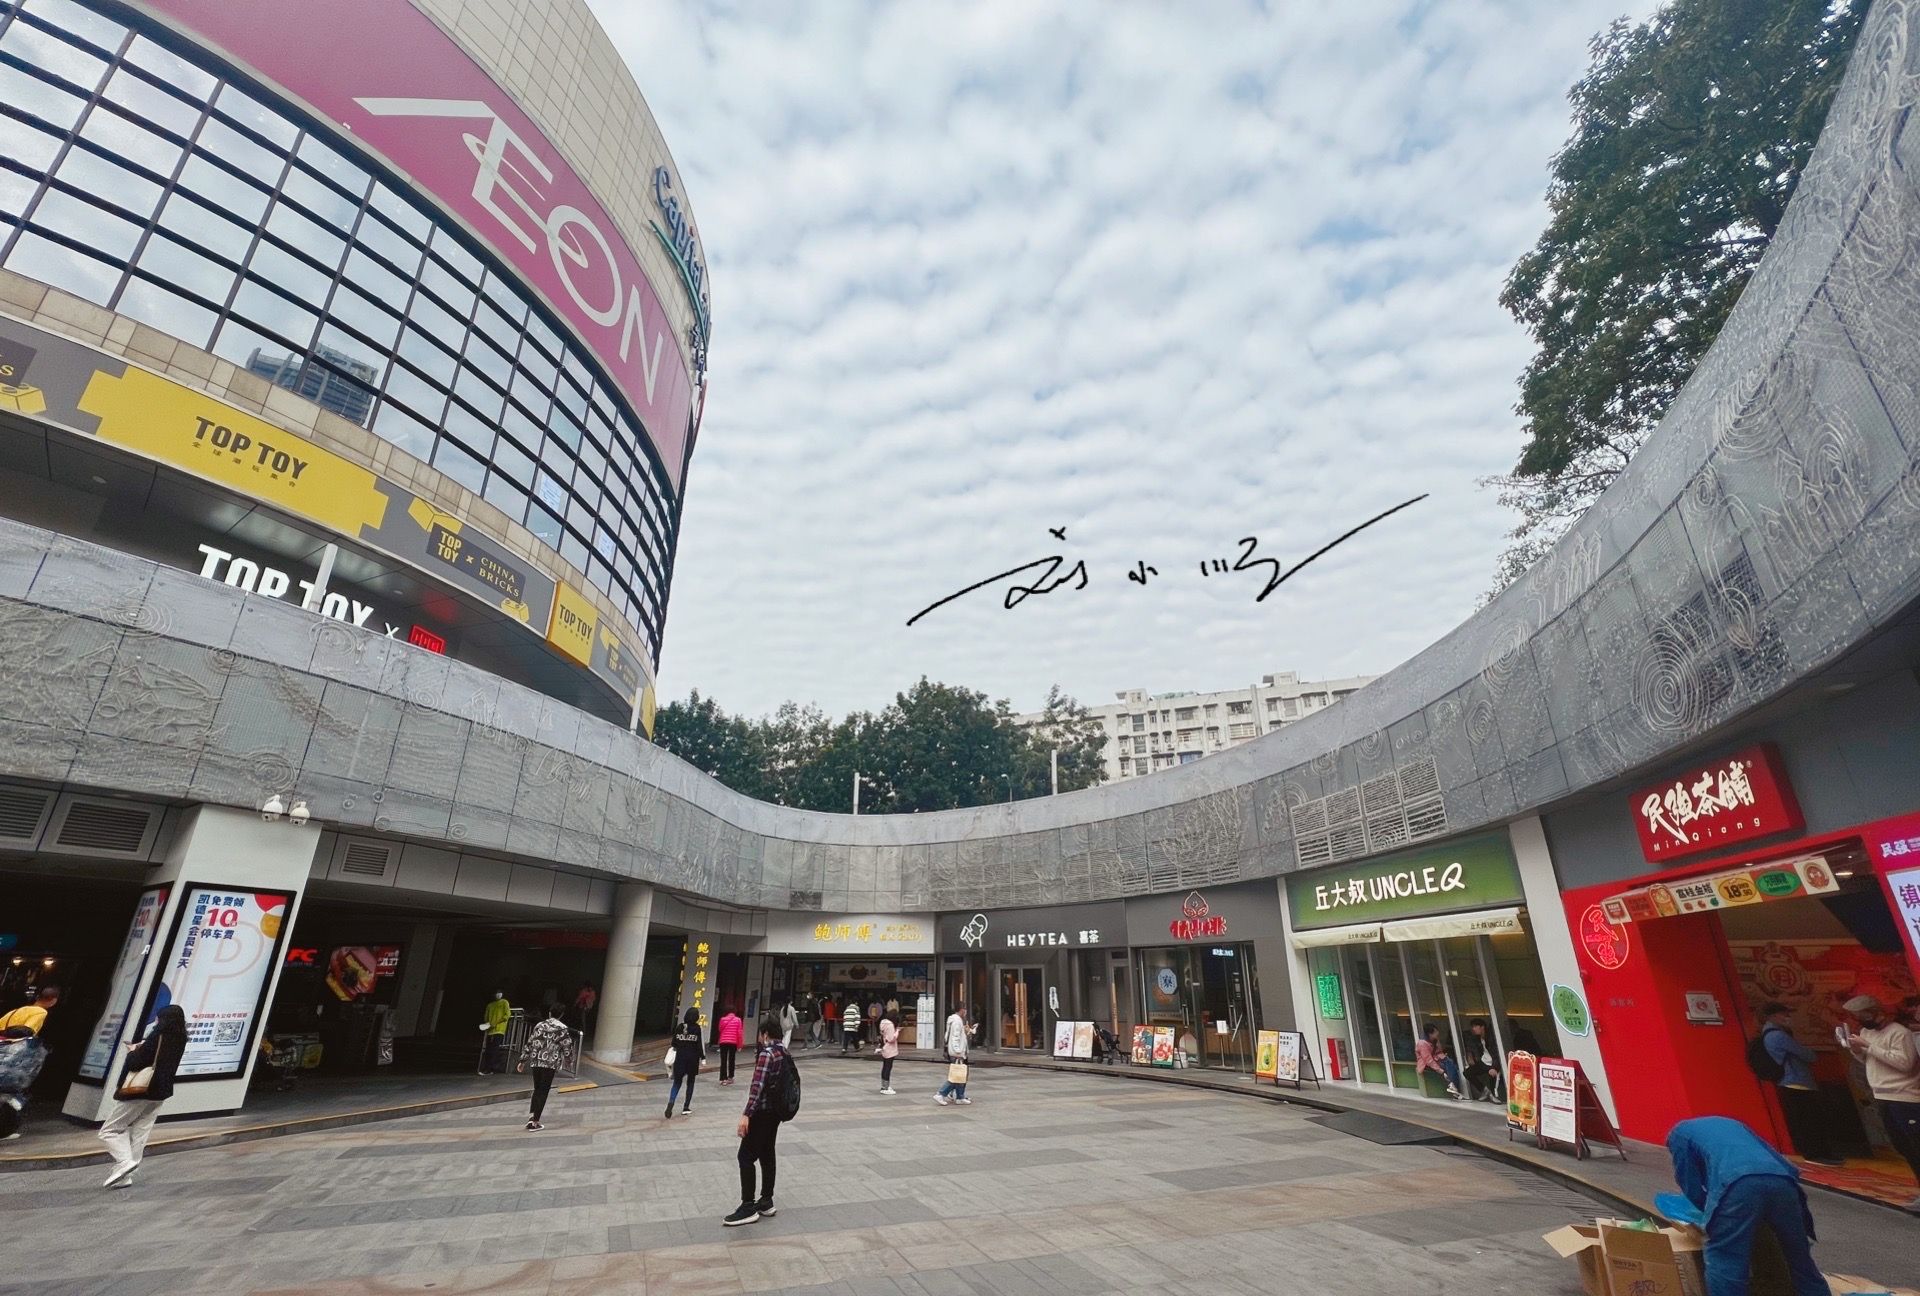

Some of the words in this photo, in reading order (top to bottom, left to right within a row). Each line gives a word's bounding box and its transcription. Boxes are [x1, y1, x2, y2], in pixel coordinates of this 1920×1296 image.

[195, 416, 251, 454] TOP
[257, 441, 308, 480] TOY
[440, 530, 462, 550] TOP
[437, 543, 459, 564] TOY
[480, 556, 516, 584] CHINA
[478, 567, 520, 598] BRICKS
[559, 603, 576, 627] TOP
[576, 617, 592, 641] TOY
[1315, 878, 1368, 911] 丘大叔
[208, 908, 239, 928] 10
[200, 928, 235, 940] 停车费
[814, 922, 873, 943] 鲍师傅
[1006, 932, 1069, 947] HEYTEA
[1079, 929, 1100, 945] 喜茶
[693, 942, 710, 984] 鲍师傅
